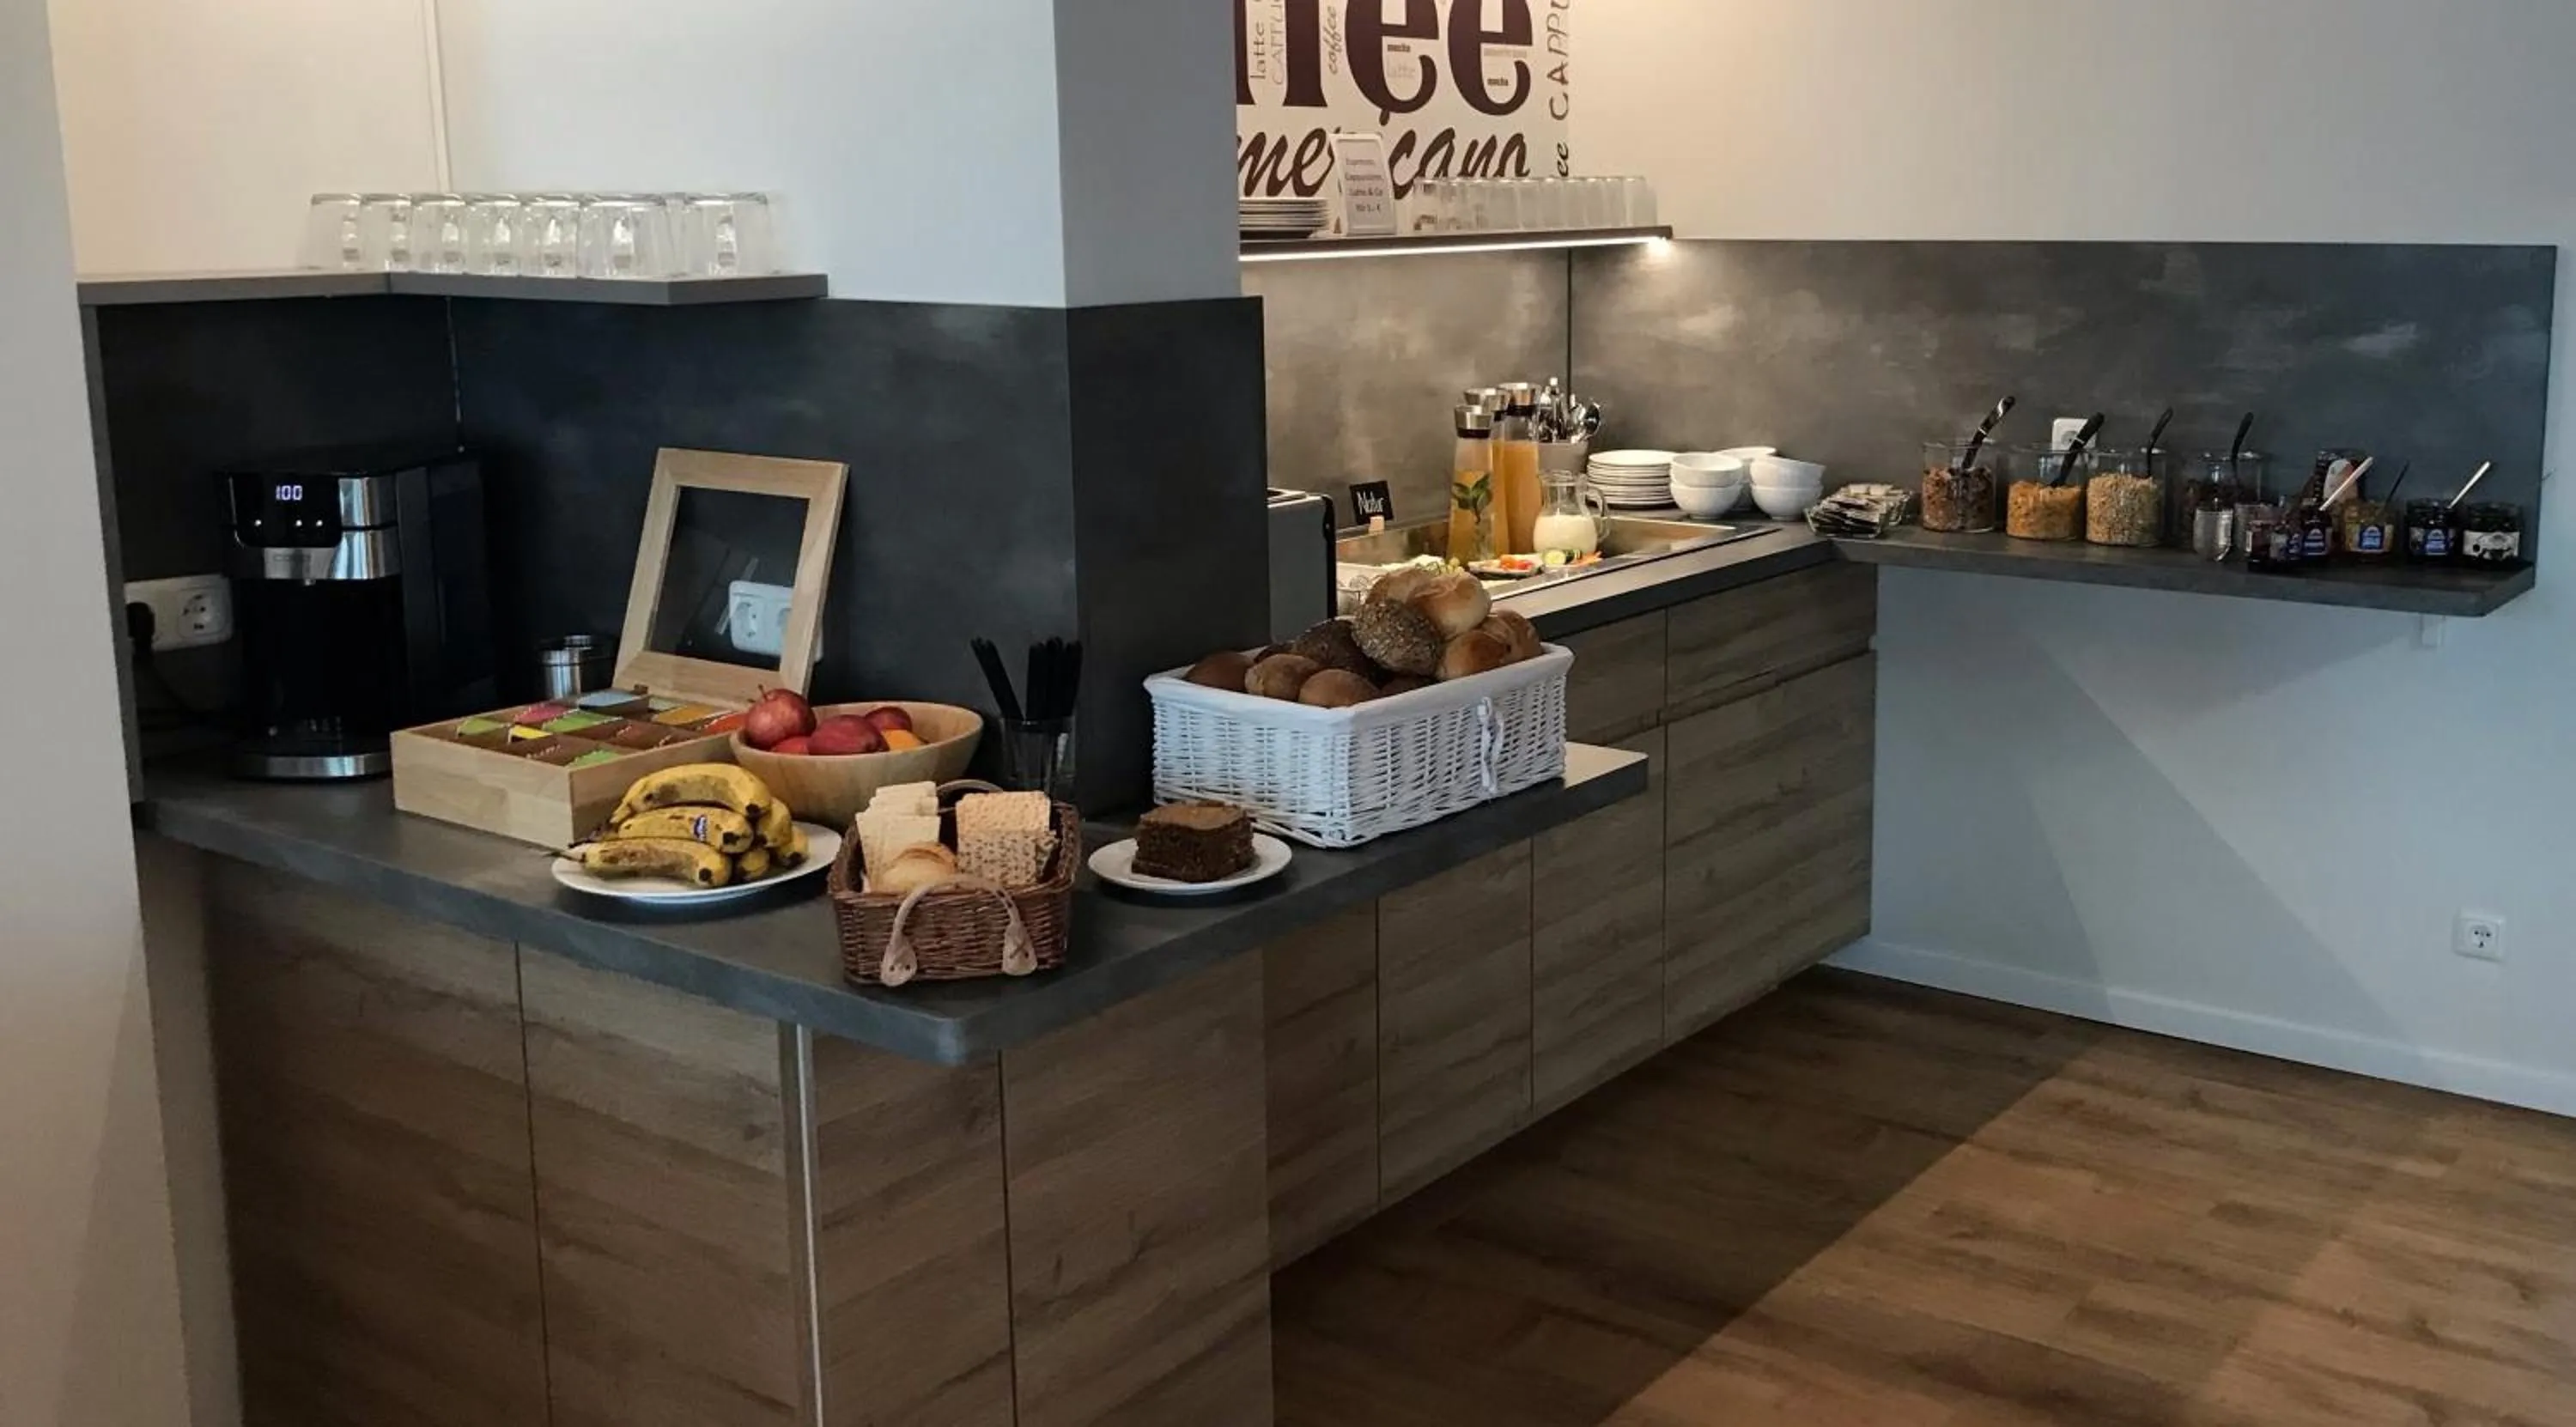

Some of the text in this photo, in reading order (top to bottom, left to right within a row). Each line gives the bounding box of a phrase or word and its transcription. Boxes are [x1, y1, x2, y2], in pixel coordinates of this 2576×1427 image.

[1250, 21, 1266, 80] latte
[1323, 6, 1342, 75] coffee
[276, 485, 303, 501] 100
